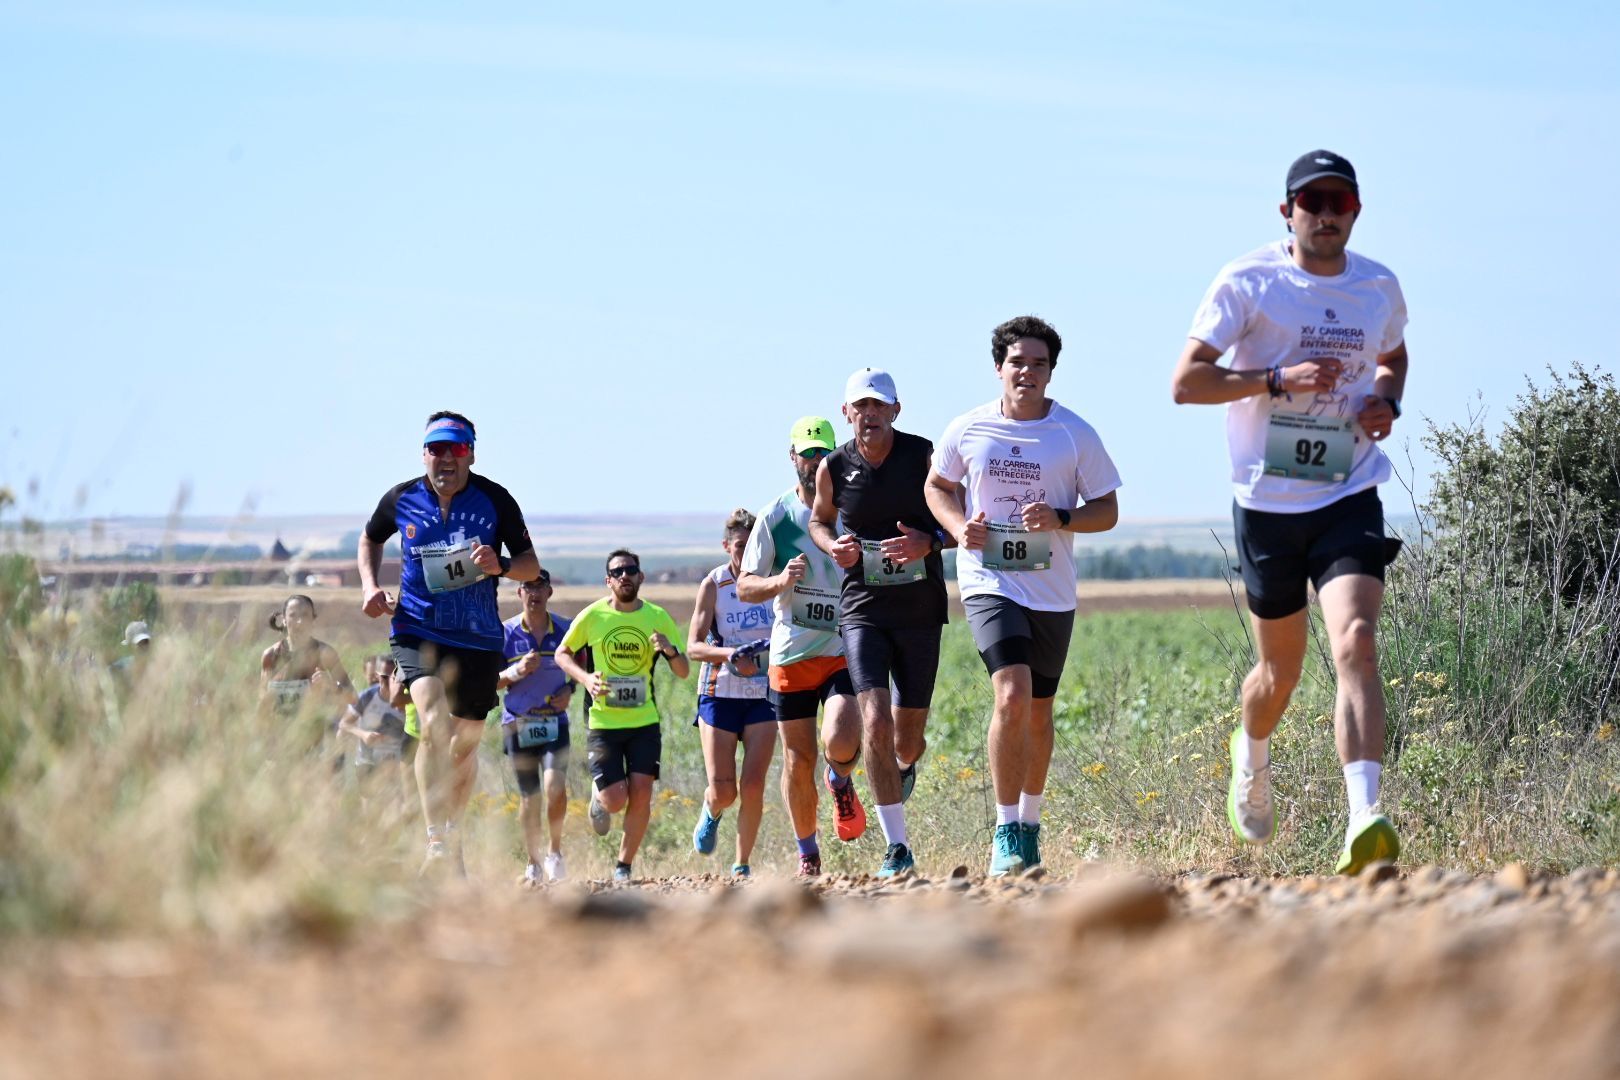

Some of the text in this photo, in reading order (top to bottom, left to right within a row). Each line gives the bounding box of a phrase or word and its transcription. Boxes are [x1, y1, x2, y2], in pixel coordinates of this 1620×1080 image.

[1301, 326, 1364, 338] XV CARRERA
[1300, 339, 1364, 351] ENTRECEPAS
[1295, 439, 1327, 466] 92
[1003, 460, 1041, 470] CARRERA
[989, 470, 1041, 481] ENTRECEPAS
[1003, 541, 1027, 560] 68
[444, 560, 465, 580] 14
[882, 557, 906, 575] 32
[805, 602, 835, 622] 196
[614, 642, 640, 651] VAGOS
[617, 687, 637, 701] 134
[528, 727, 548, 739] 163
